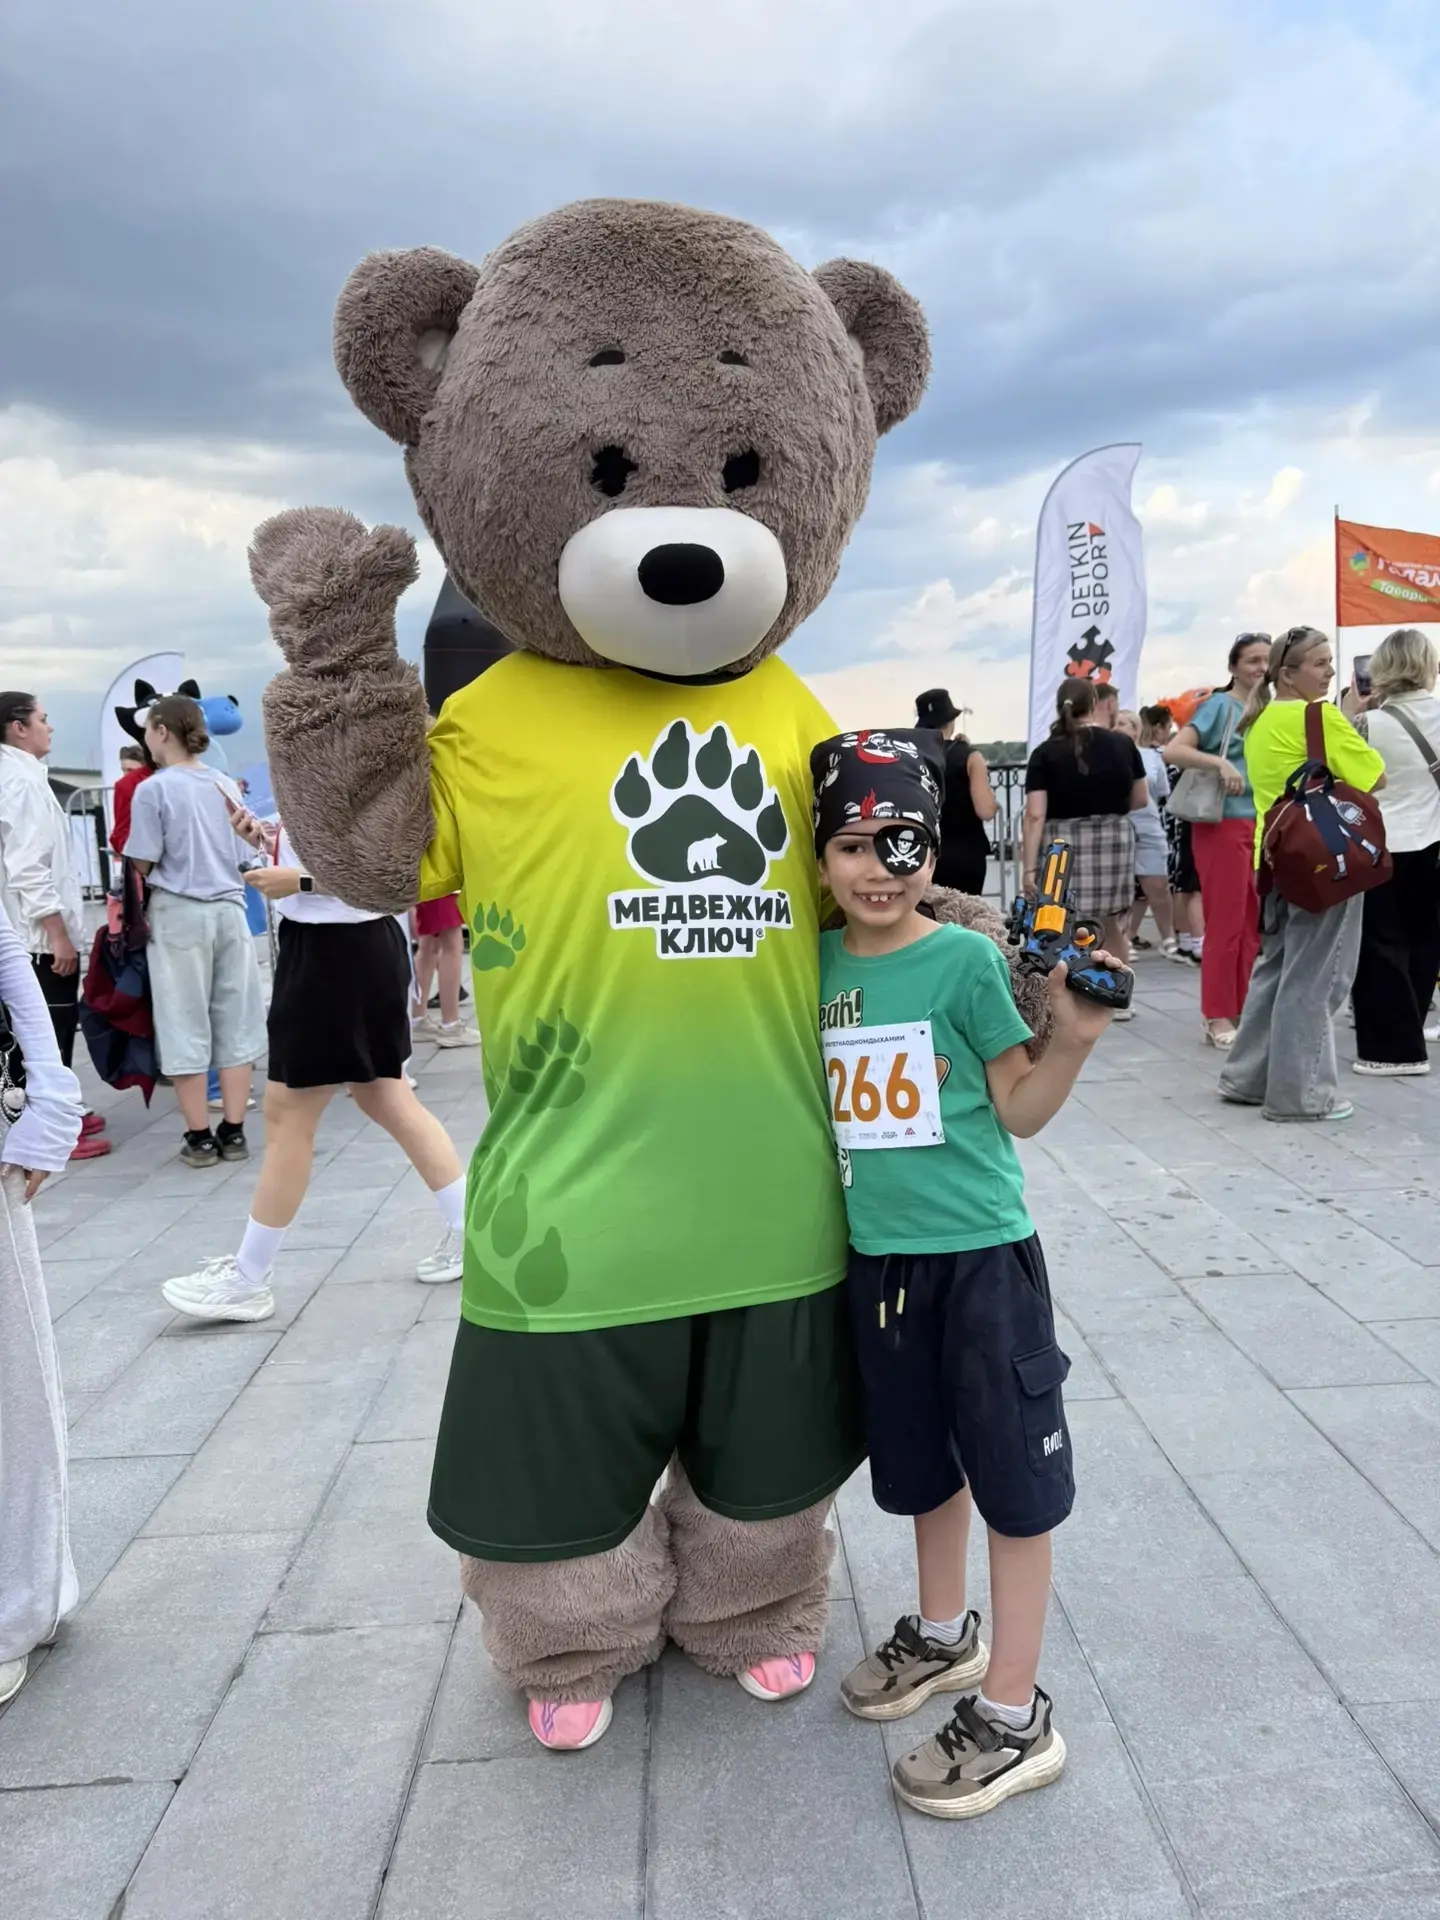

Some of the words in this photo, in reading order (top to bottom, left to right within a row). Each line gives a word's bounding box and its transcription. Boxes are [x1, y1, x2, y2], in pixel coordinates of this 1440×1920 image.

[1067, 521, 1091, 619] DETKIN
[1088, 521, 1110, 616] SPORT
[614, 891, 791, 924] МЕДВЕЖИЙ
[828, 1053, 920, 1122] 266
